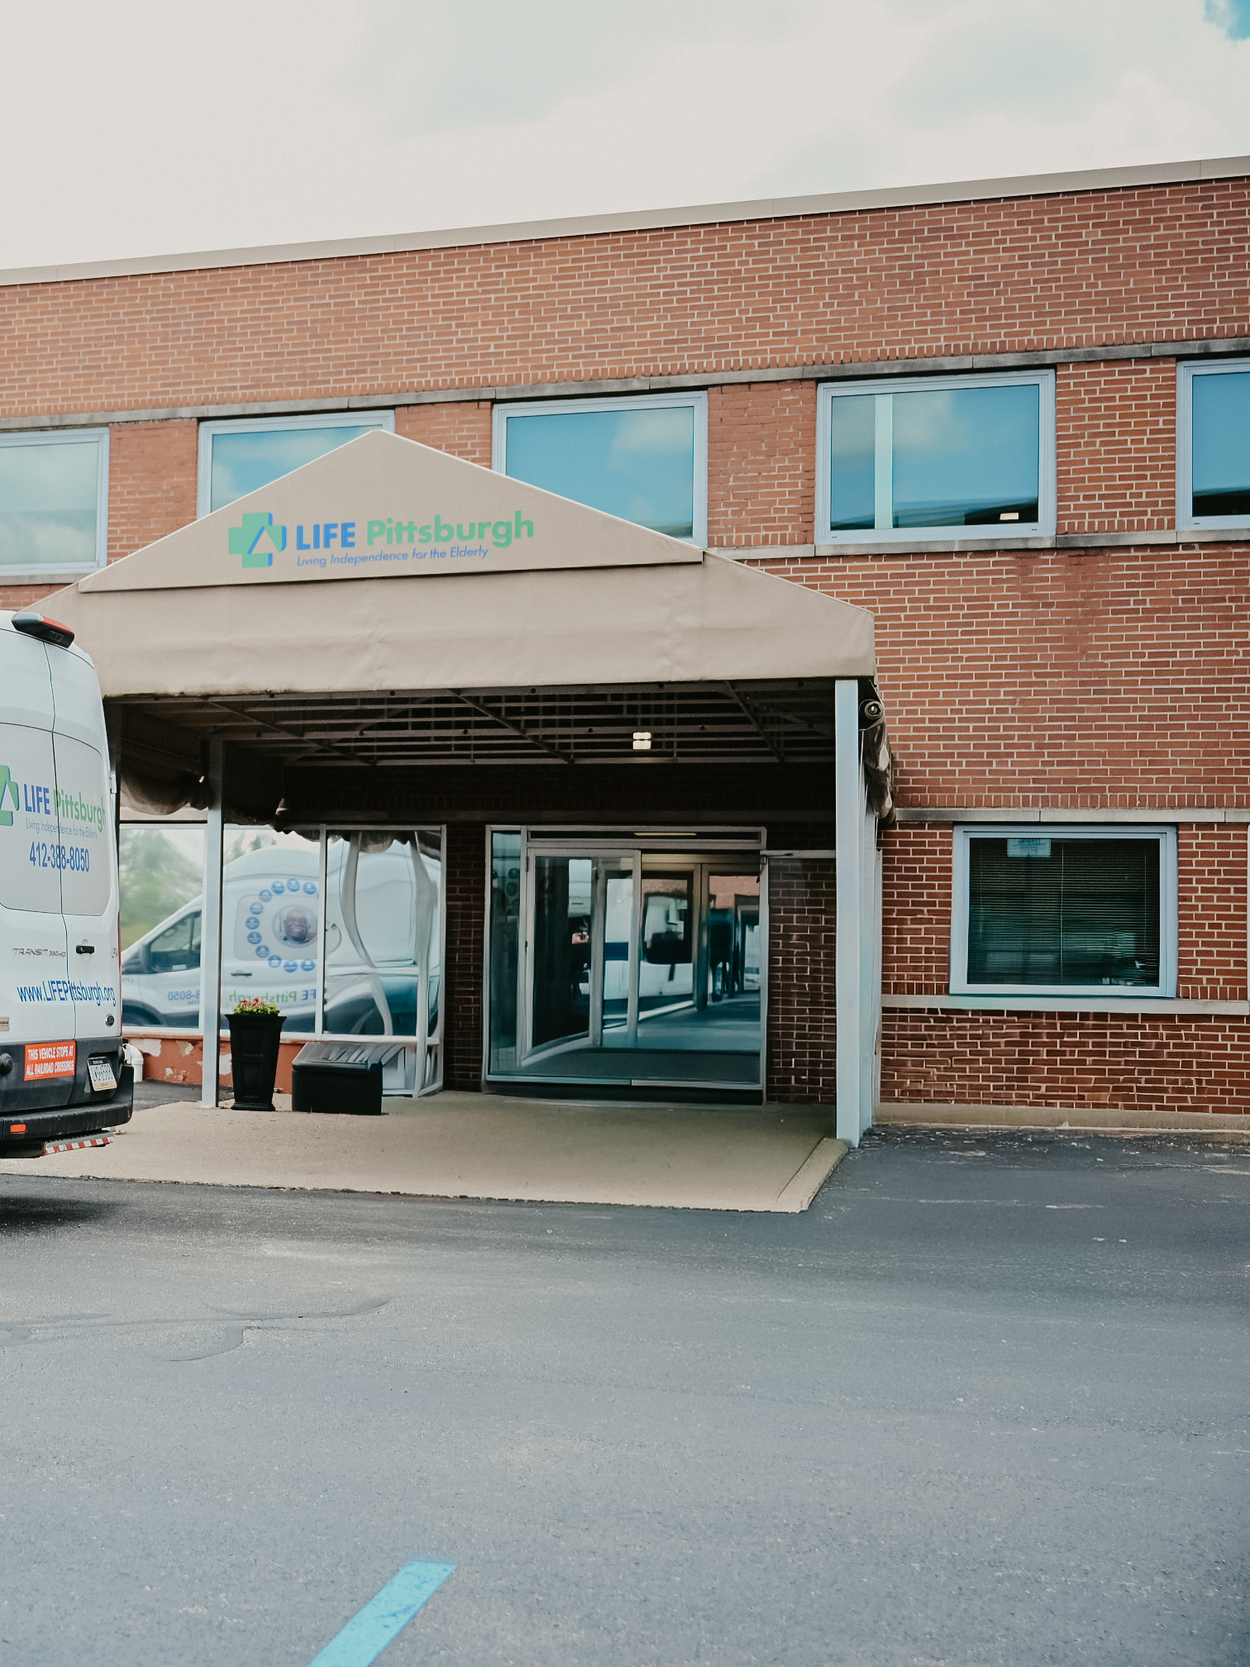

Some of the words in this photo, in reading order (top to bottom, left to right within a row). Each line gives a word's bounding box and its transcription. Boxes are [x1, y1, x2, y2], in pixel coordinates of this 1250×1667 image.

[296, 522, 356, 550] LIFE
[367, 510, 534, 549] Pittsburgh
[297, 555, 327, 568] Living
[330, 550, 409, 566] Independence
[411, 548, 427, 560] for
[429, 547, 446, 559] the
[450, 545, 489, 560] Elderly
[23, 783, 51, 815] LIFE
[53, 788, 107, 833] Pittsburgh
[29, 841, 90, 872] 412-388-8050
[12, 948, 49, 956] TRANSIT
[16, 980, 117, 1007] www.LIFEPittsburgh.org
[27, 1048, 39, 1061] THIS
[39, 1046, 56, 1060] VEHICLE
[56, 1045, 69, 1058] STOPS
[68, 1045, 74, 1057] AT
[26, 1064, 34, 1076] ALL
[34, 1062, 54, 1075] RAILROAD
[54, 1059, 75, 1073] CROSSINGS
